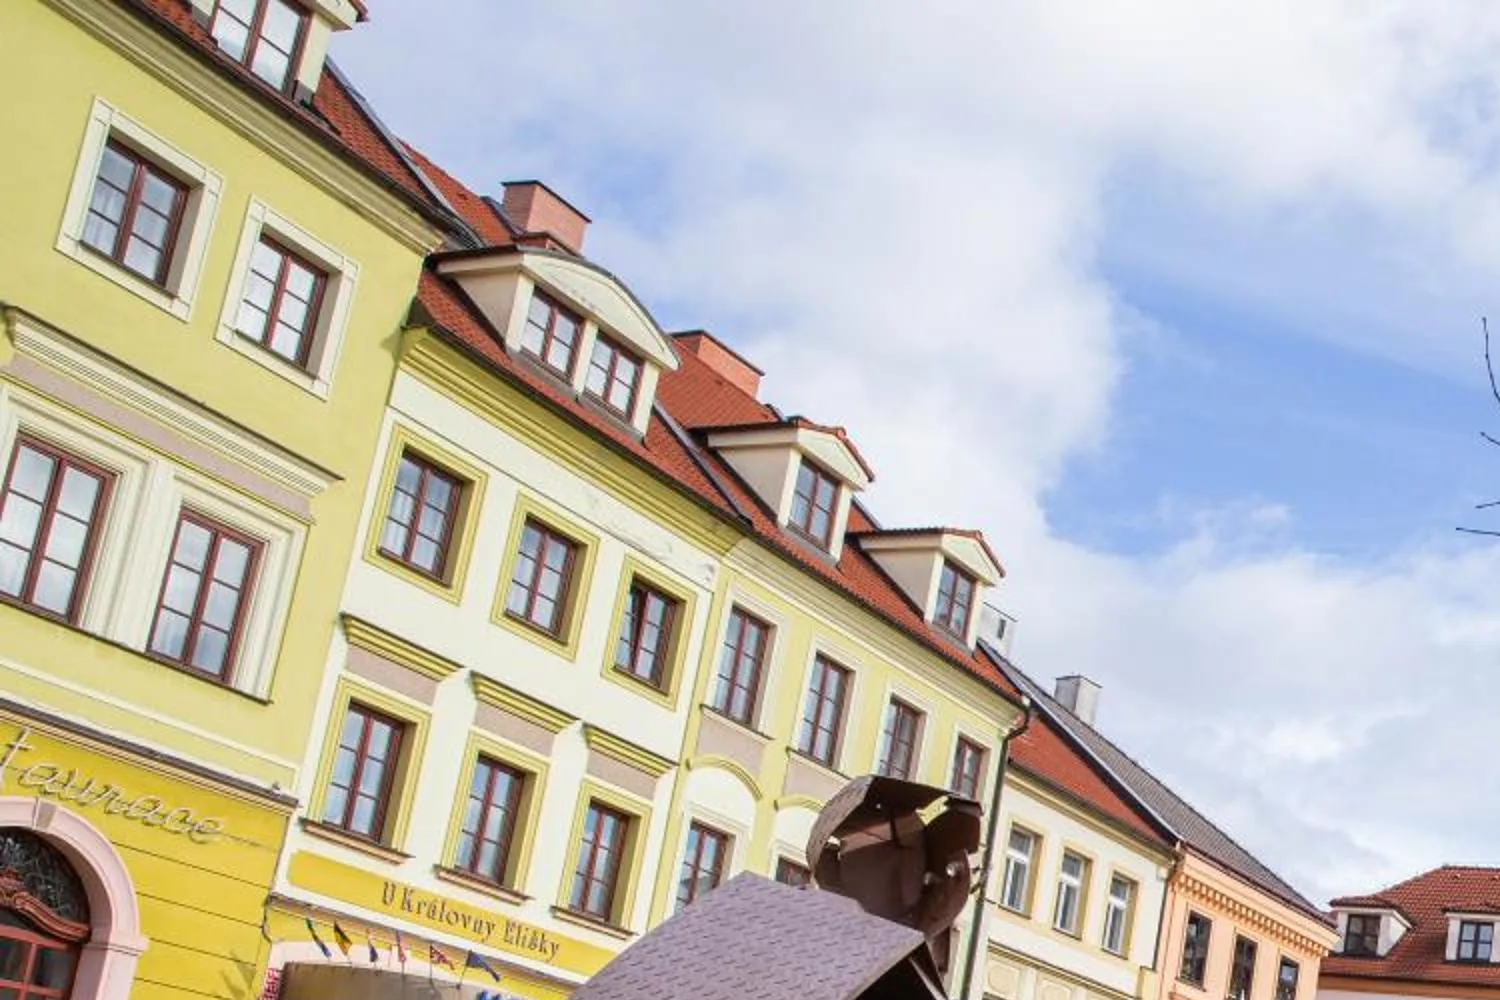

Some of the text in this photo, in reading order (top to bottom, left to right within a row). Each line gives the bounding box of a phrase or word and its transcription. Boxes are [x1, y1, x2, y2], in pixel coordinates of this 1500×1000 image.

[382, 881, 561, 963] U Královny Elišky
